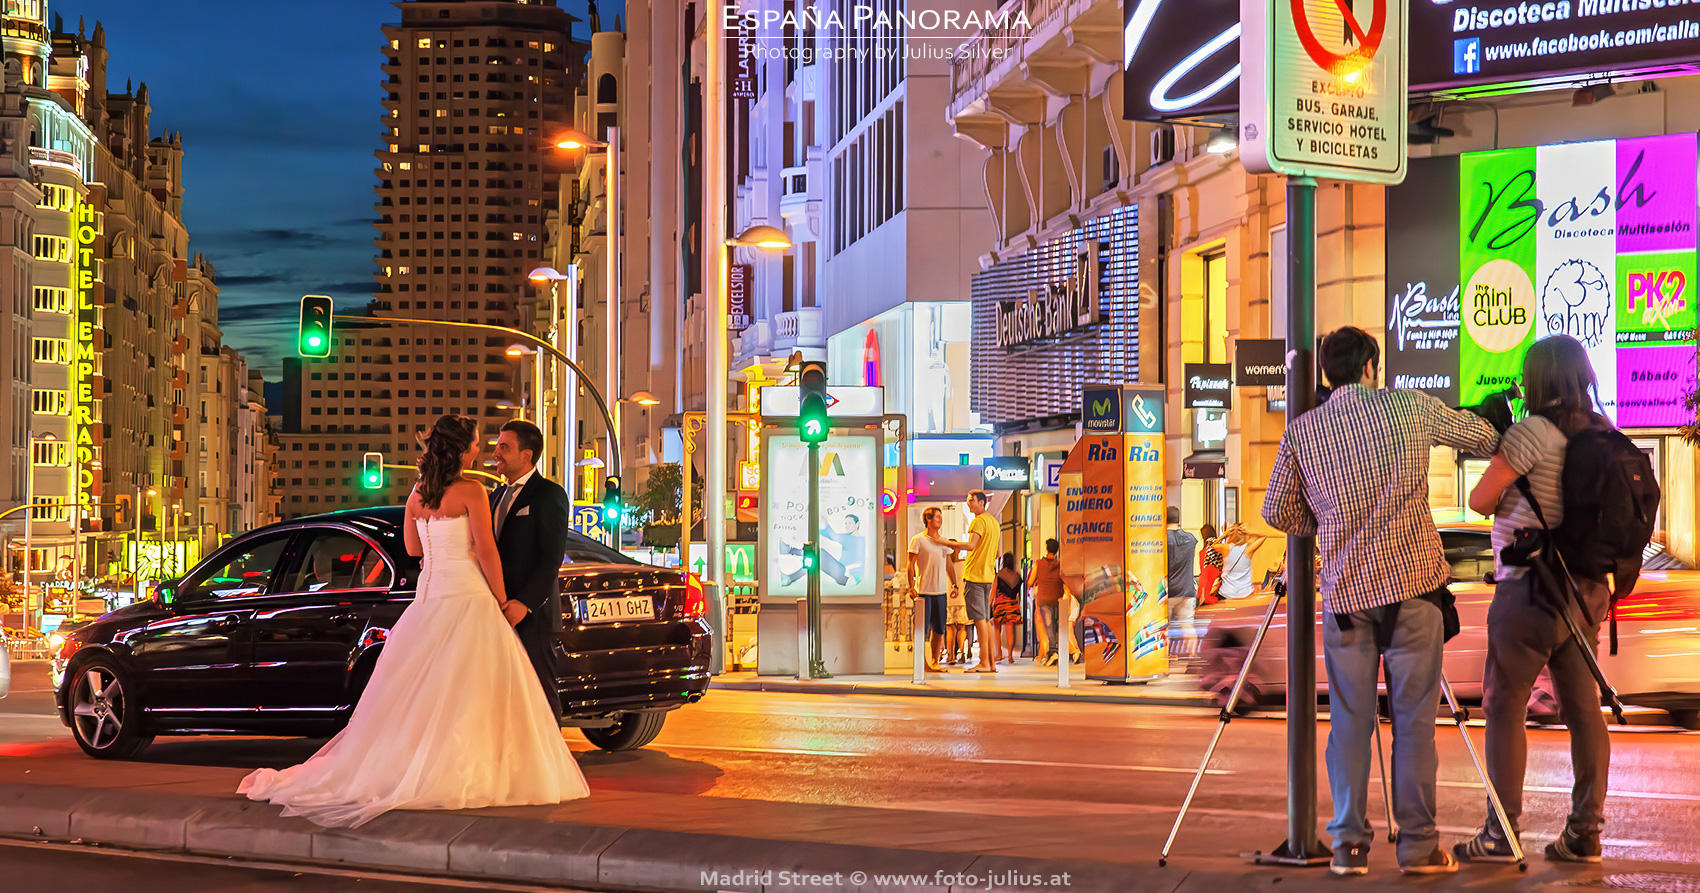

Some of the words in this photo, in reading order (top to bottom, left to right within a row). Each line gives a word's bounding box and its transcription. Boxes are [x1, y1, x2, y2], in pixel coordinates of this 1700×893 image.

[1453, 0, 1571, 32] Discoteca
[1288, 117, 1344, 136] SERVICIO
[1350, 123, 1387, 142] HOTEL
[1296, 138, 1304, 152] Y
[1310, 139, 1378, 160] BICICLETAS
[1469, 150, 1656, 250] Bash
[1554, 227, 1614, 240] Discoteca
[77, 203, 96, 310] HOTEL
[730, 266, 744, 315] EXCELSIOR
[1400, 281, 1460, 317] Bash
[996, 290, 1042, 348] Deutsche
[1045, 278, 1075, 337] Bank
[1473, 307, 1527, 327] CLUB
[76, 322, 95, 511] EMPERADOR
[1087, 419, 1116, 428] movistar
[1088, 438, 1117, 461] Ria
[1129, 438, 1160, 462] Ria
[1066, 485, 1098, 497] ENVIOS
[1100, 484, 1113, 495] DE
[1129, 493, 1163, 502] DINERO
[786, 501, 808, 513] PO
[1066, 497, 1114, 512] DINERO
[1066, 522, 1113, 535] CHANGE
[1129, 514, 1162, 522] CHANGE
[591, 601, 623, 618] 2411
[626, 600, 650, 615] GHZ
